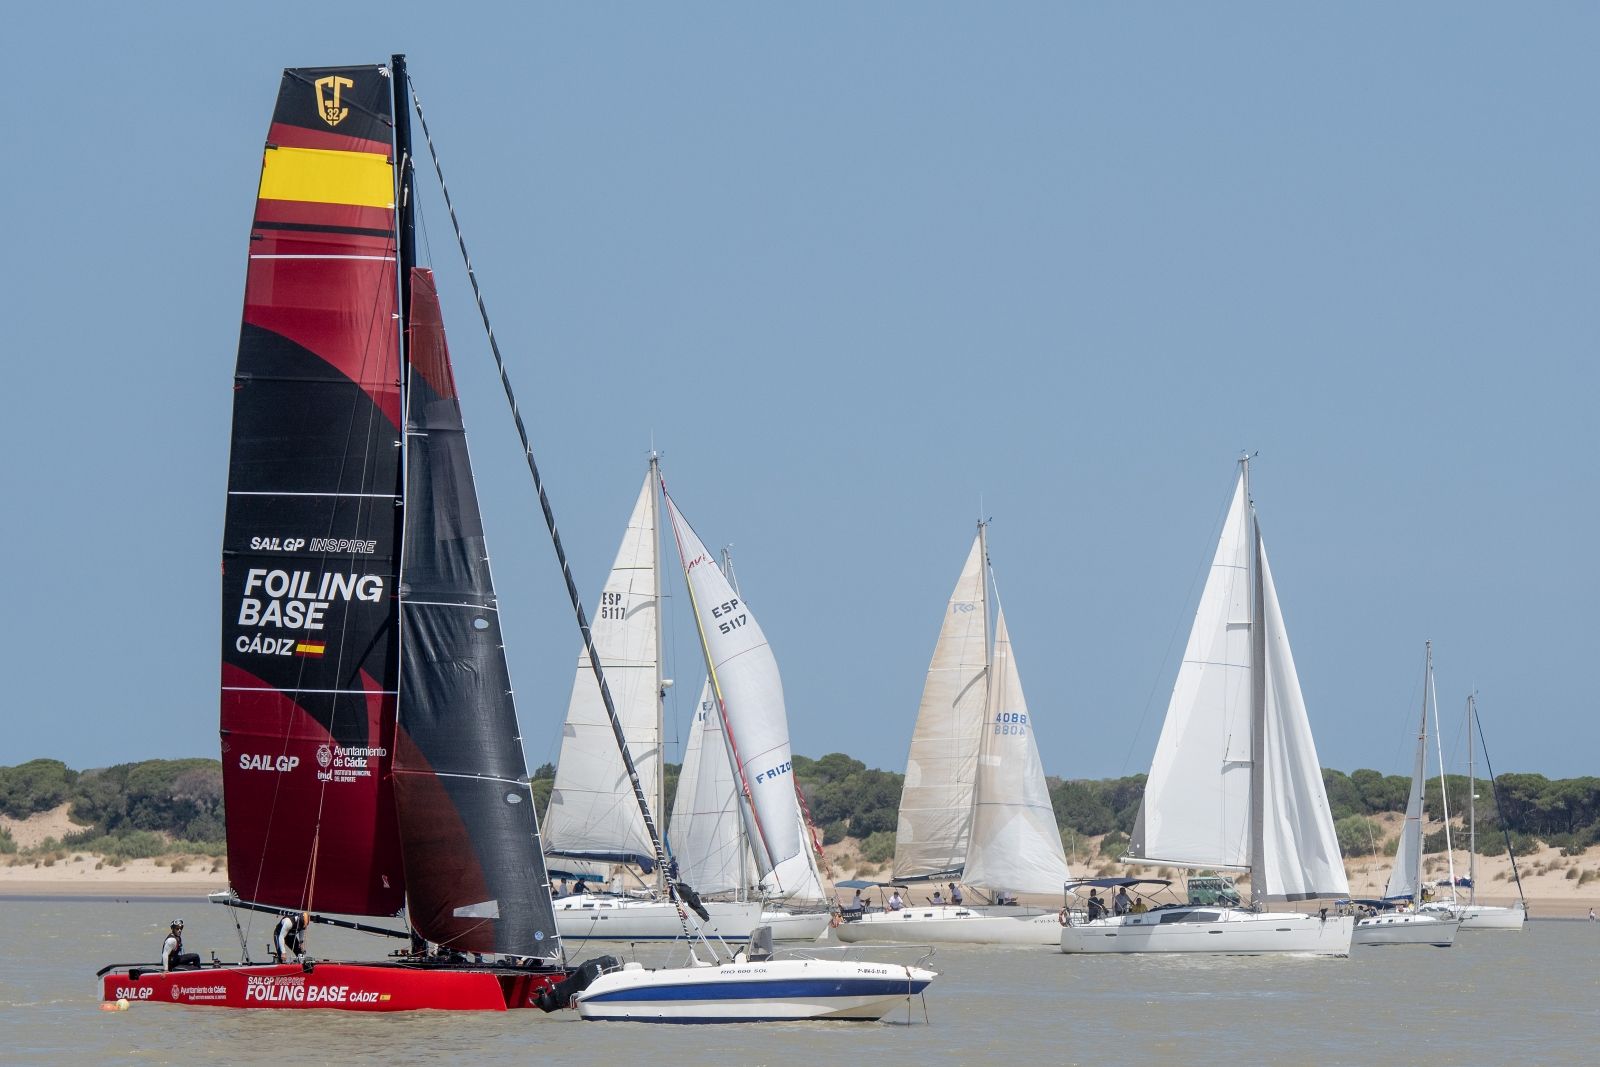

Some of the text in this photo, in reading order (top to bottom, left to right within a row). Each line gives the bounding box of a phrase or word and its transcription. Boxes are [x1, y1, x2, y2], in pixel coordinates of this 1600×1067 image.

[327, 108, 340, 121] 32
[309, 538, 376, 554] INSPIRE
[244, 568, 384, 603] FOILING
[602, 592, 621, 606] ESP
[238, 598, 329, 630] BASE
[601, 606, 626, 620] 5117
[711, 598, 739, 619] ESP
[718, 613, 747, 635] 5117
[236, 632, 295, 656] CÁDIZ
[996, 712, 1027, 724] 4088
[333, 745, 387, 758] Ayuntamiento
[333, 756, 368, 768] de Cádiz
[245, 984, 379, 1003] FOILING BASE CÁDIZ
